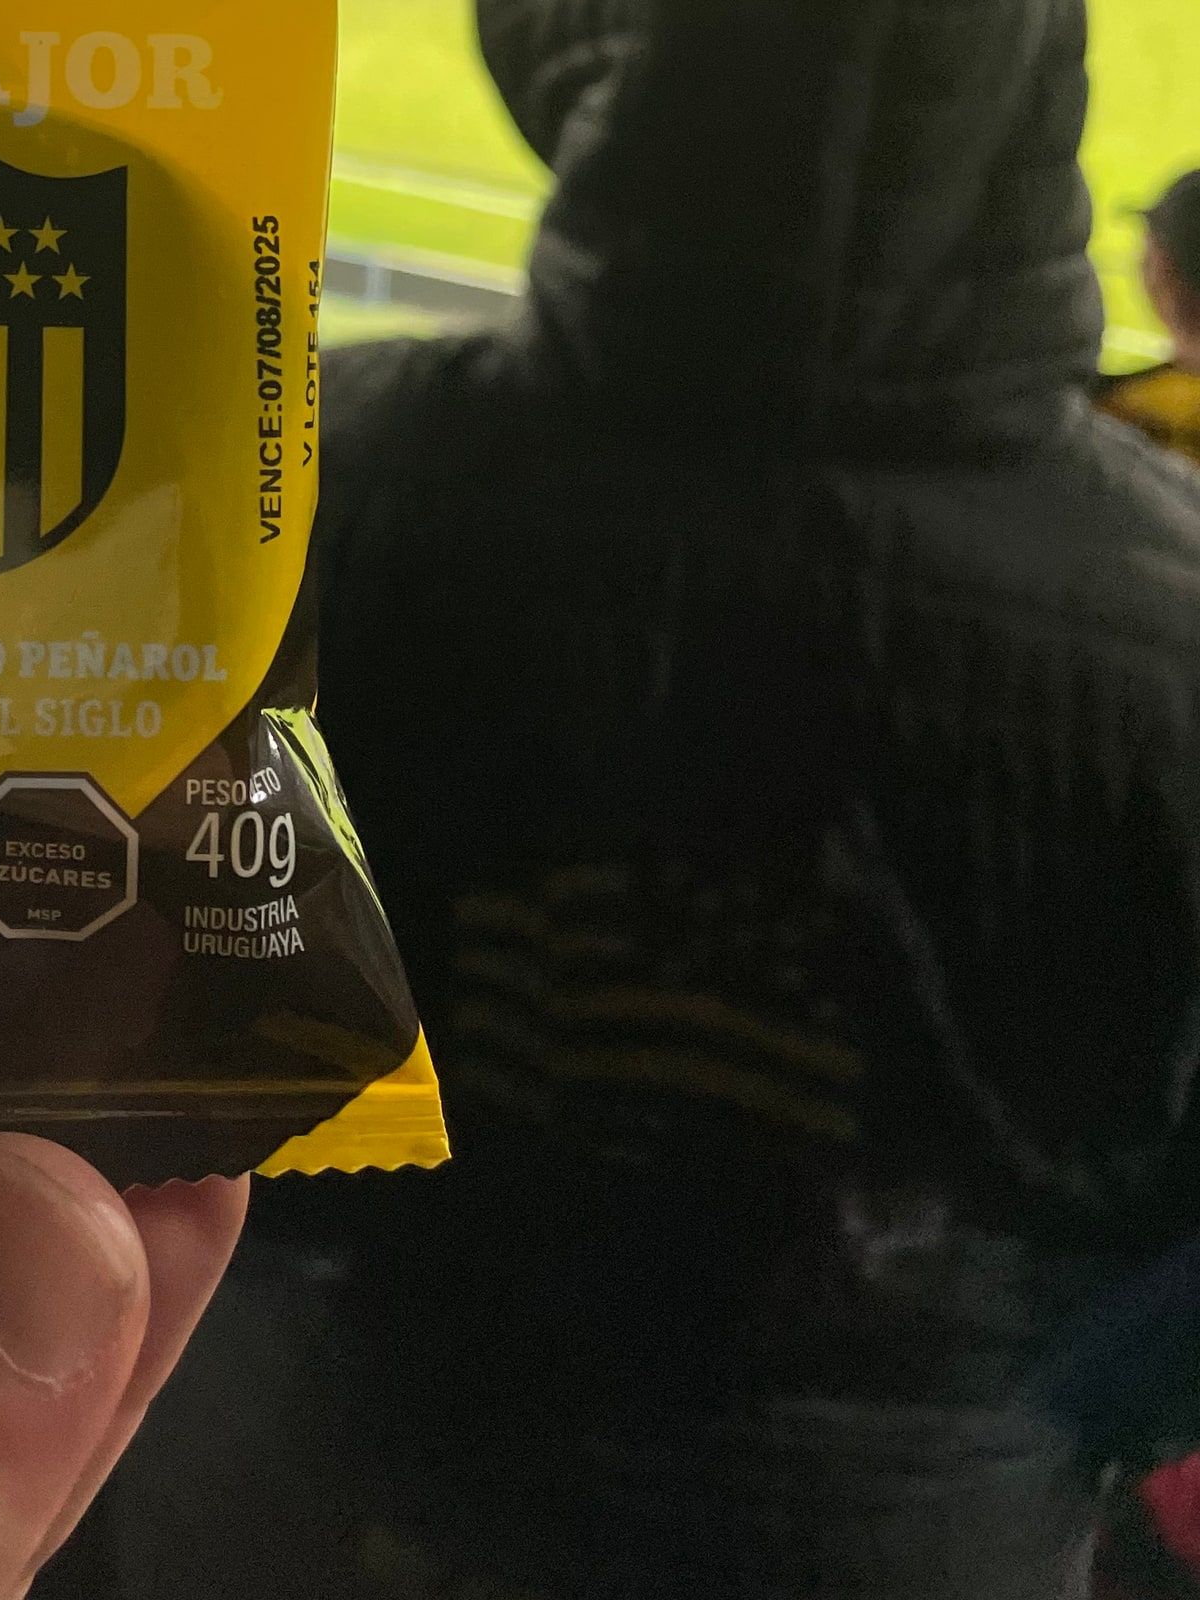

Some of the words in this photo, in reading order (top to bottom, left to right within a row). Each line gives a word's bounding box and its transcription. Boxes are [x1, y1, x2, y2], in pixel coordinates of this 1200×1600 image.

[308, 258, 321, 318] 154
[253, 215, 282, 544] VENCE:07/08/2025
[304, 332, 319, 430] LOTE
[18, 632, 228, 682] PEÑAROL
[34, 700, 163, 738] SIGLO
[186, 779, 247, 806] PESO
[5, 841, 86, 862] EXCESO
[186, 810, 297, 889] 40g
[26, 908, 62, 923] MSP
[184, 894, 300, 933] INDUSTRIA
[184, 926, 305, 959] URUGUAYA
